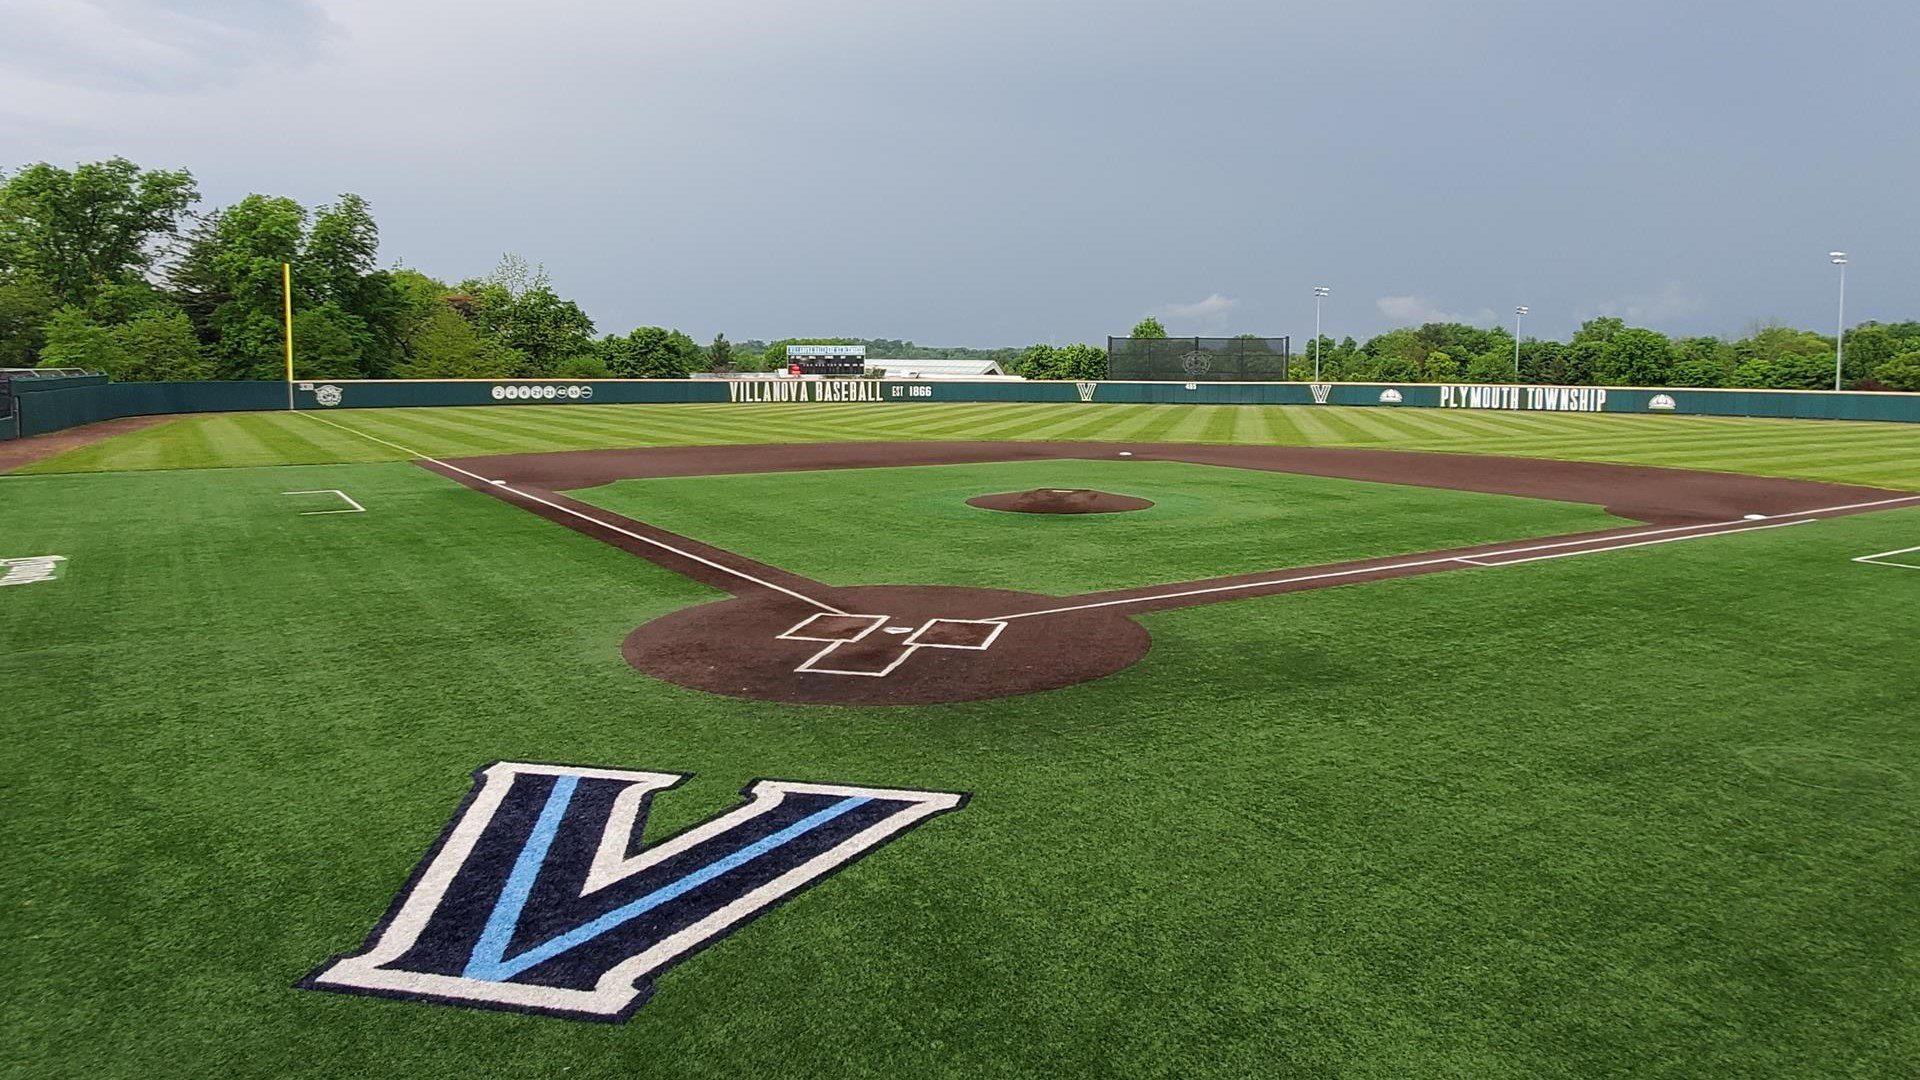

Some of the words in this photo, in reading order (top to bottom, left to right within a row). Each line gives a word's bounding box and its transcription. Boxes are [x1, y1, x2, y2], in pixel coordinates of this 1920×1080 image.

[729, 381, 809, 402] VILLANOVA
[815, 381, 883, 402] BASEBALL
[892, 386, 904, 397] EST
[909, 386, 932, 397] 1866
[1076, 383, 1097, 401] V
[1310, 384, 1332, 404] V
[1440, 386, 1519, 409] PLYMOUTH
[1527, 387, 1607, 412] TOWNSHIP
[297, 761, 971, 1023] V
